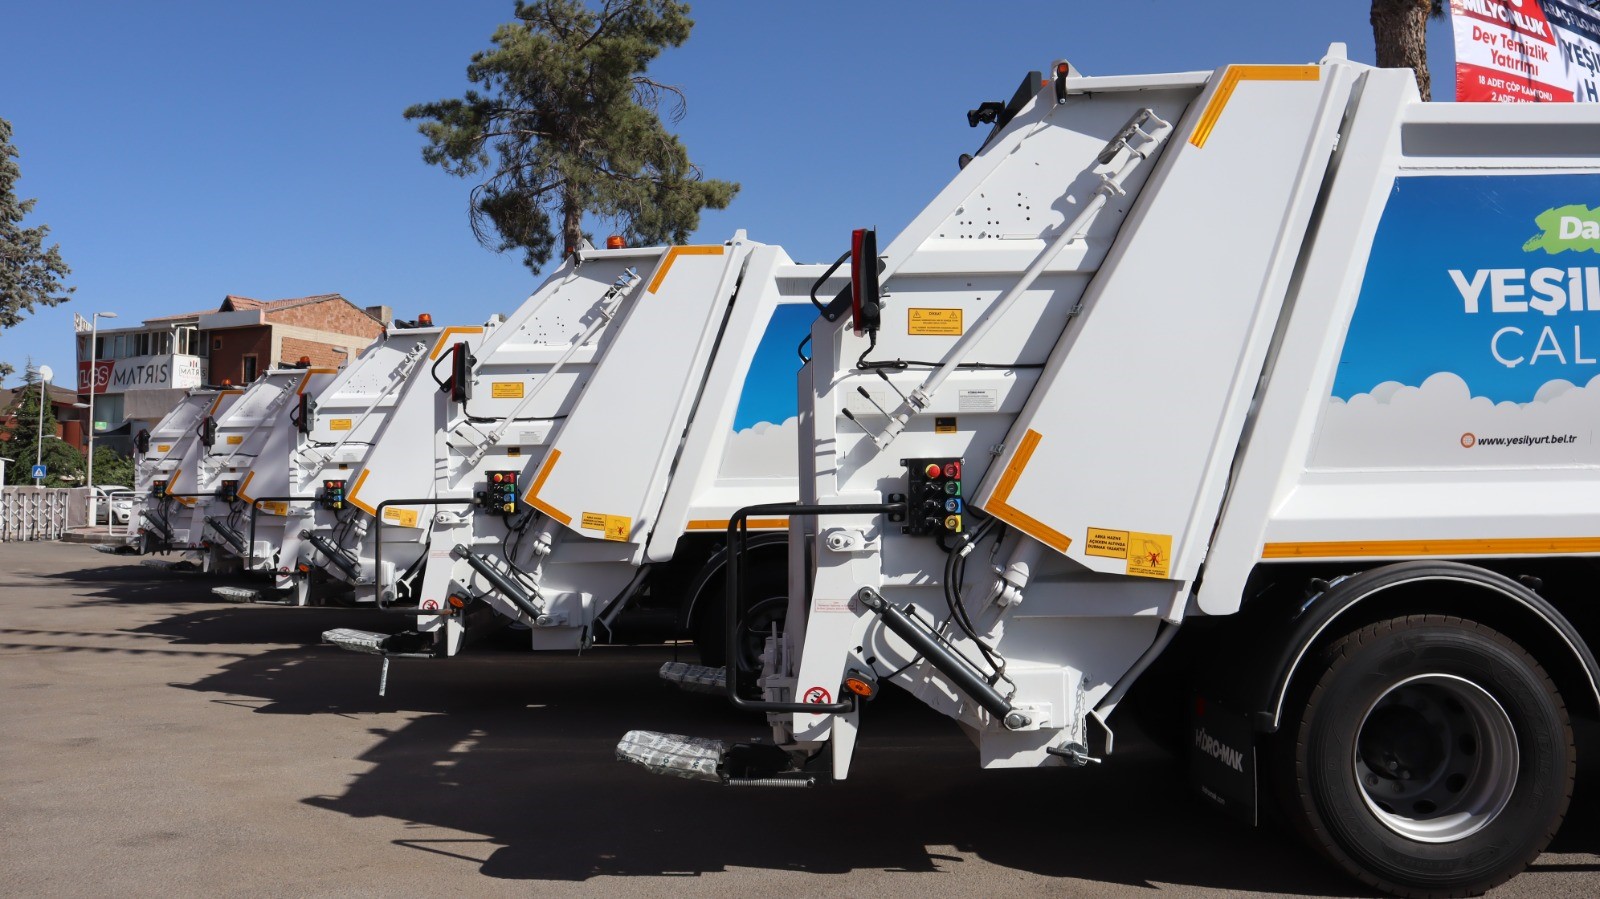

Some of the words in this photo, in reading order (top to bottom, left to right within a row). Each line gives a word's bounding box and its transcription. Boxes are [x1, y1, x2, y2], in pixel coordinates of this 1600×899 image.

[1472, 25, 1497, 46] Dev
[1500, 33, 1549, 62] Temizlik
[1490, 49, 1539, 77] Yatırımı
[1478, 75, 1486, 85] 18
[1487, 77, 1505, 89] ADET
[1506, 81, 1521, 93] ÇÖP
[1521, 85, 1553, 101] KAMYONU
[1491, 92, 1497, 101] 2
[1490, 325, 1597, 368] ÇAL
[79, 366, 109, 389] LGS
[1478, 433, 1577, 447] www.yesilyurt.bel.tr
